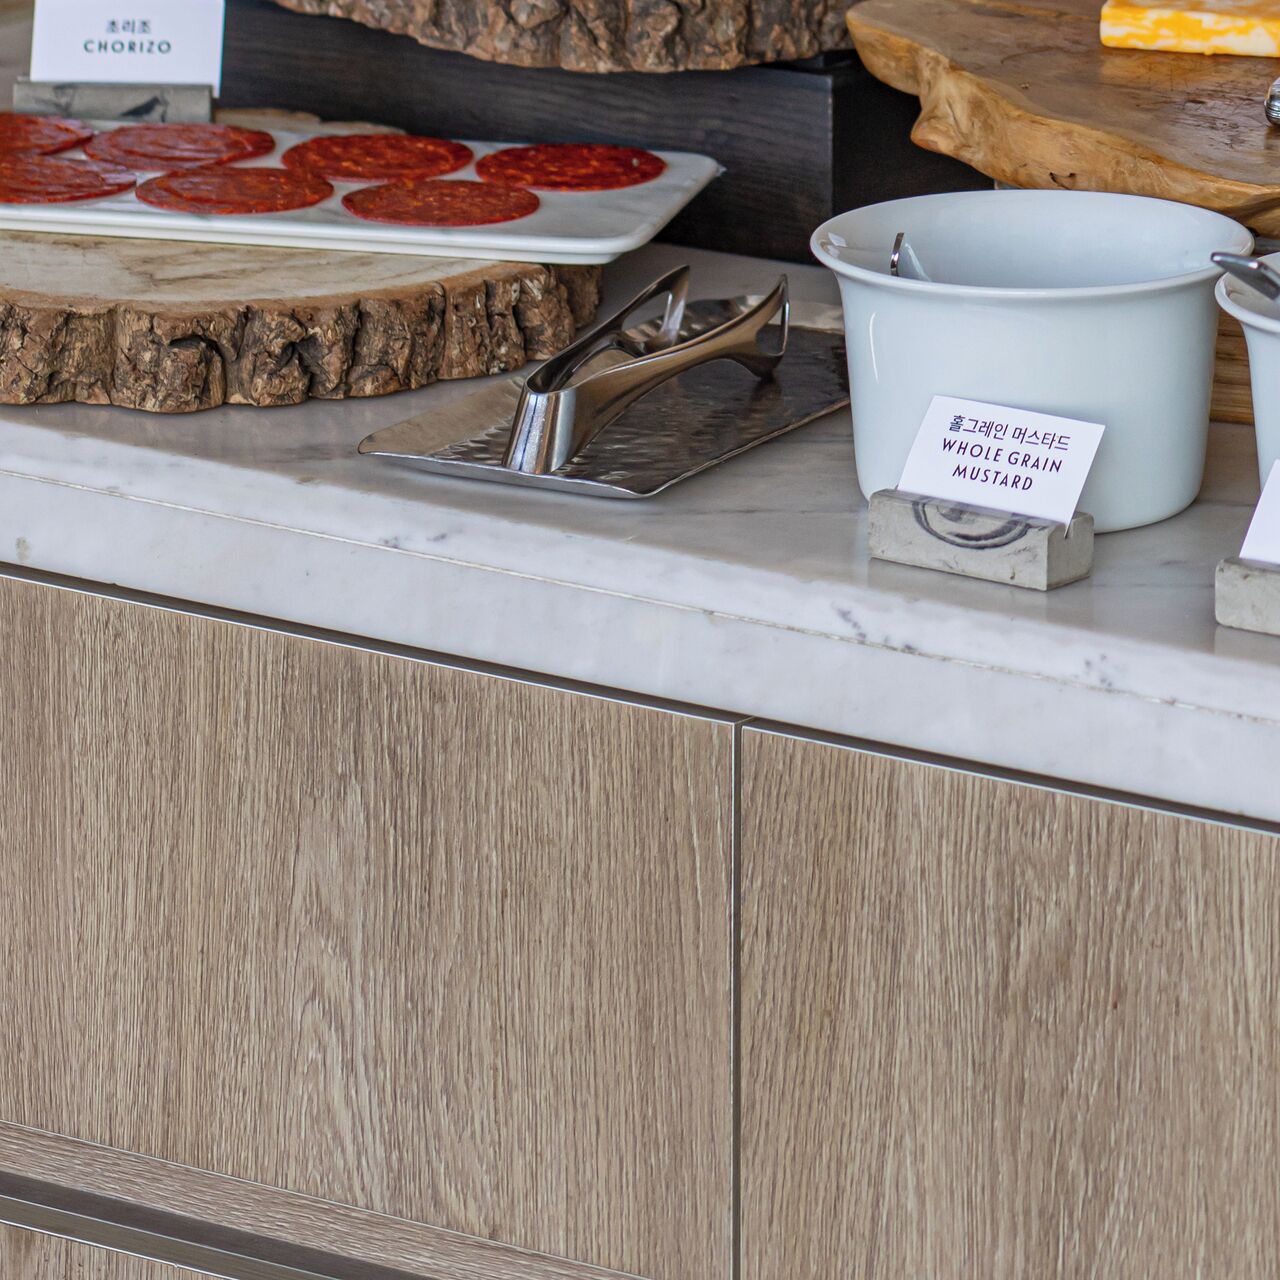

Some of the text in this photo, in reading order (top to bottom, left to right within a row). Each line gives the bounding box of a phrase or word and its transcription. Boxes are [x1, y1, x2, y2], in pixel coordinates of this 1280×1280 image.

[83, 39, 172, 54] CHORIZO
[948, 415, 1071, 451] 홀그레인 머스타드
[942, 437, 1063, 473] WHOLE GRAIN
[952, 464, 1034, 491] MUSTARD
